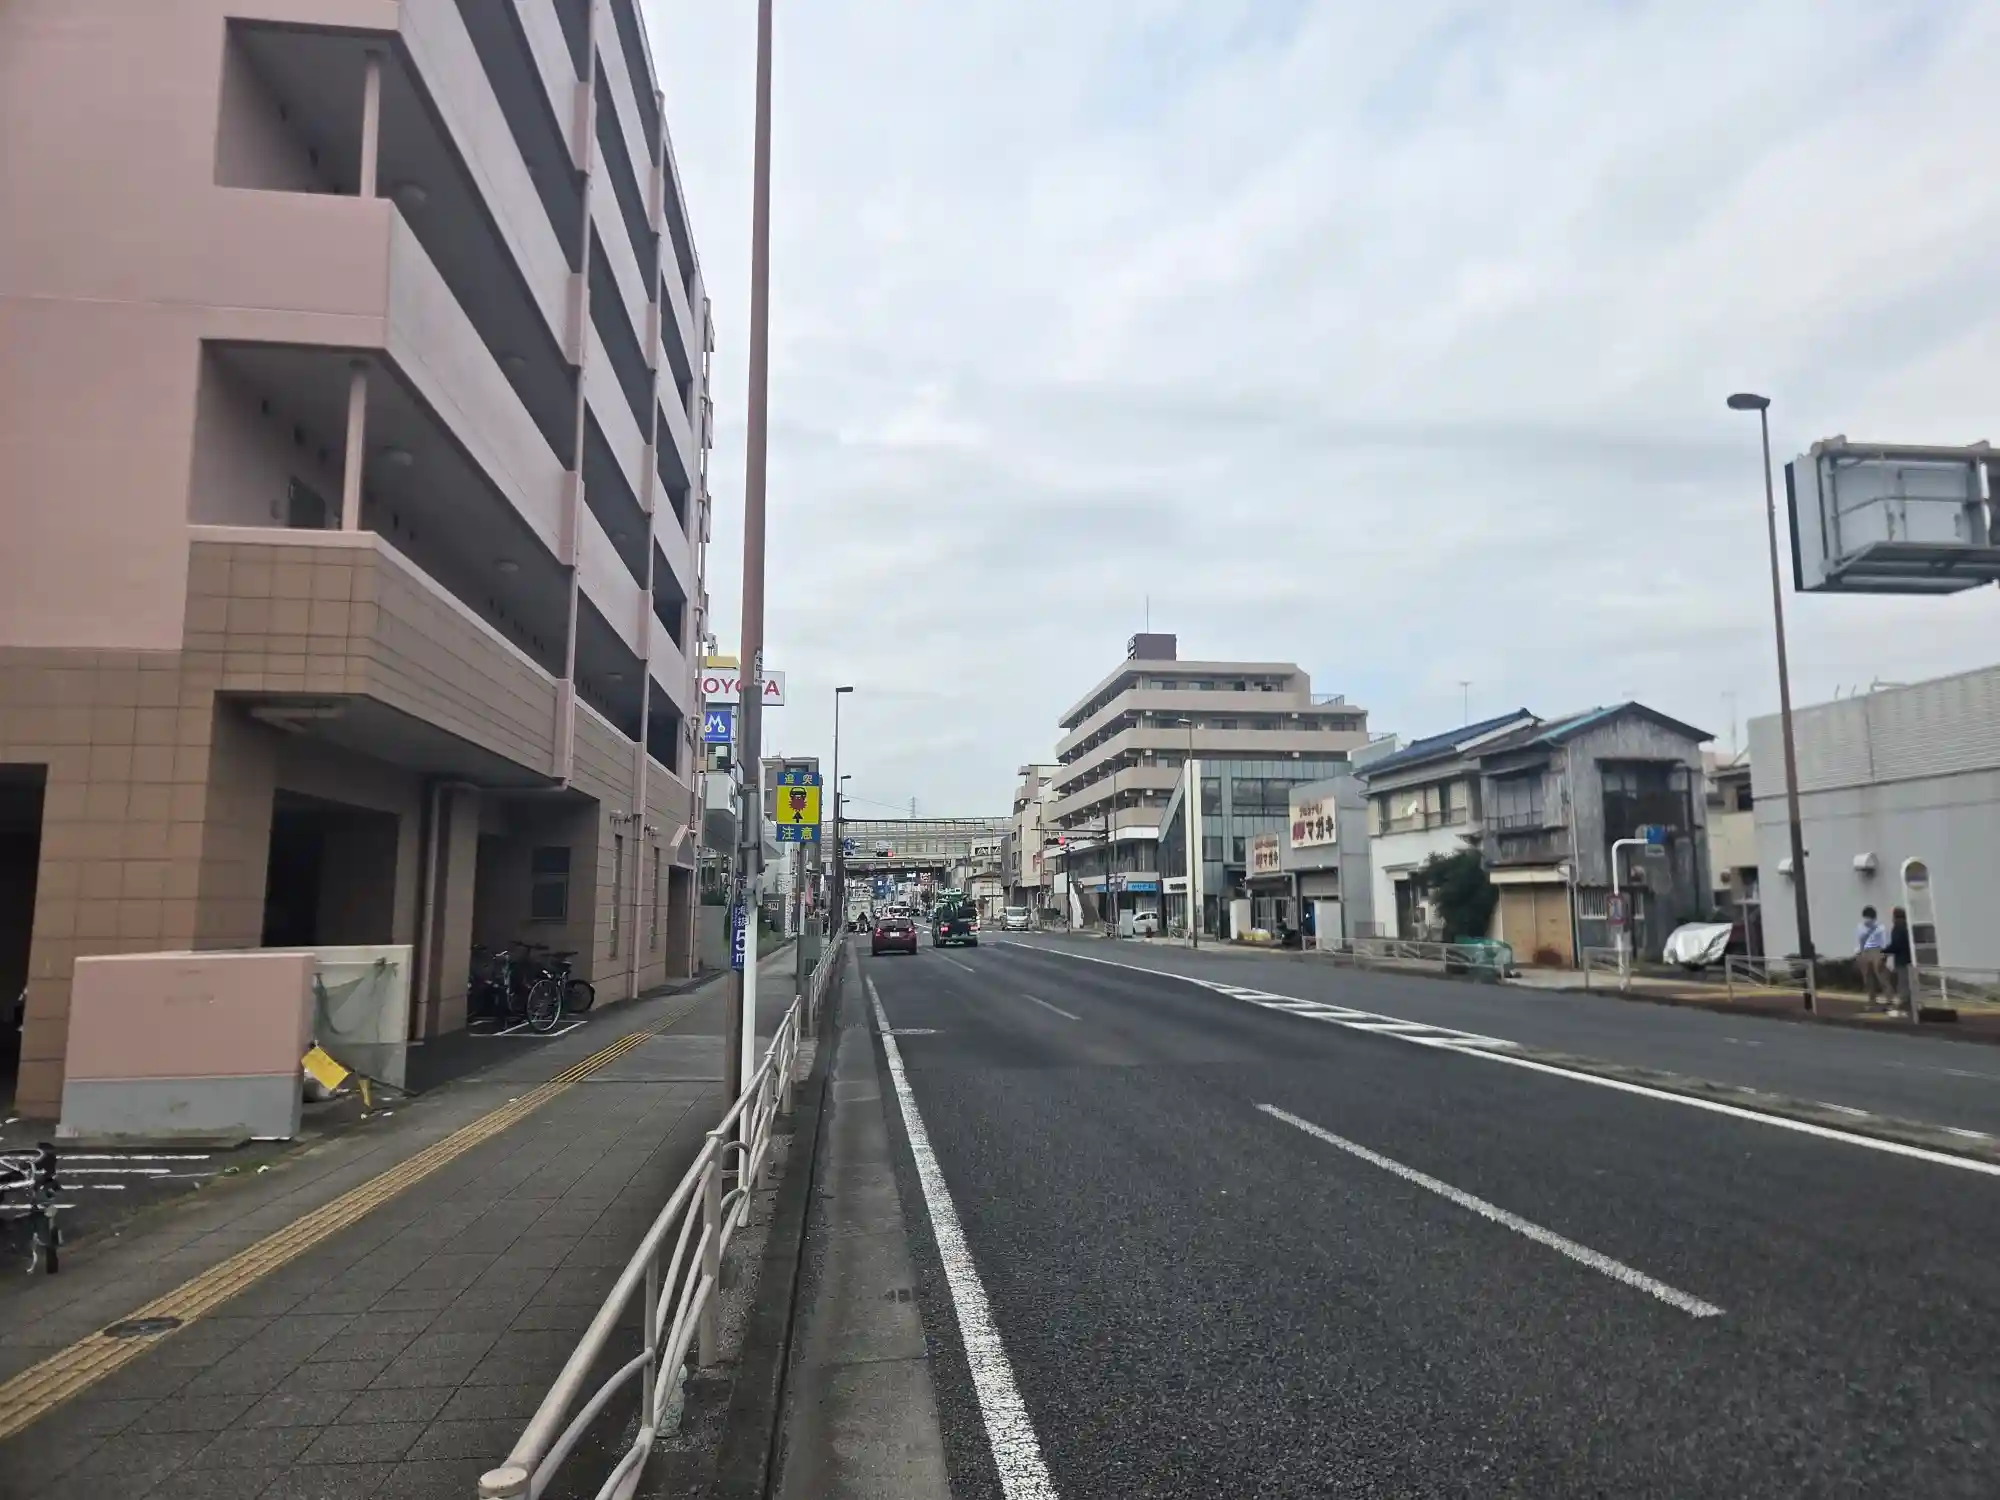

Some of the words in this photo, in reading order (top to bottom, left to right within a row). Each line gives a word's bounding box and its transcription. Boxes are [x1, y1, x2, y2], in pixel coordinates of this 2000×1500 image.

[703, 678, 780, 695] OYA
[785, 774, 812, 784] 追突
[782, 826, 812, 840] 注意
